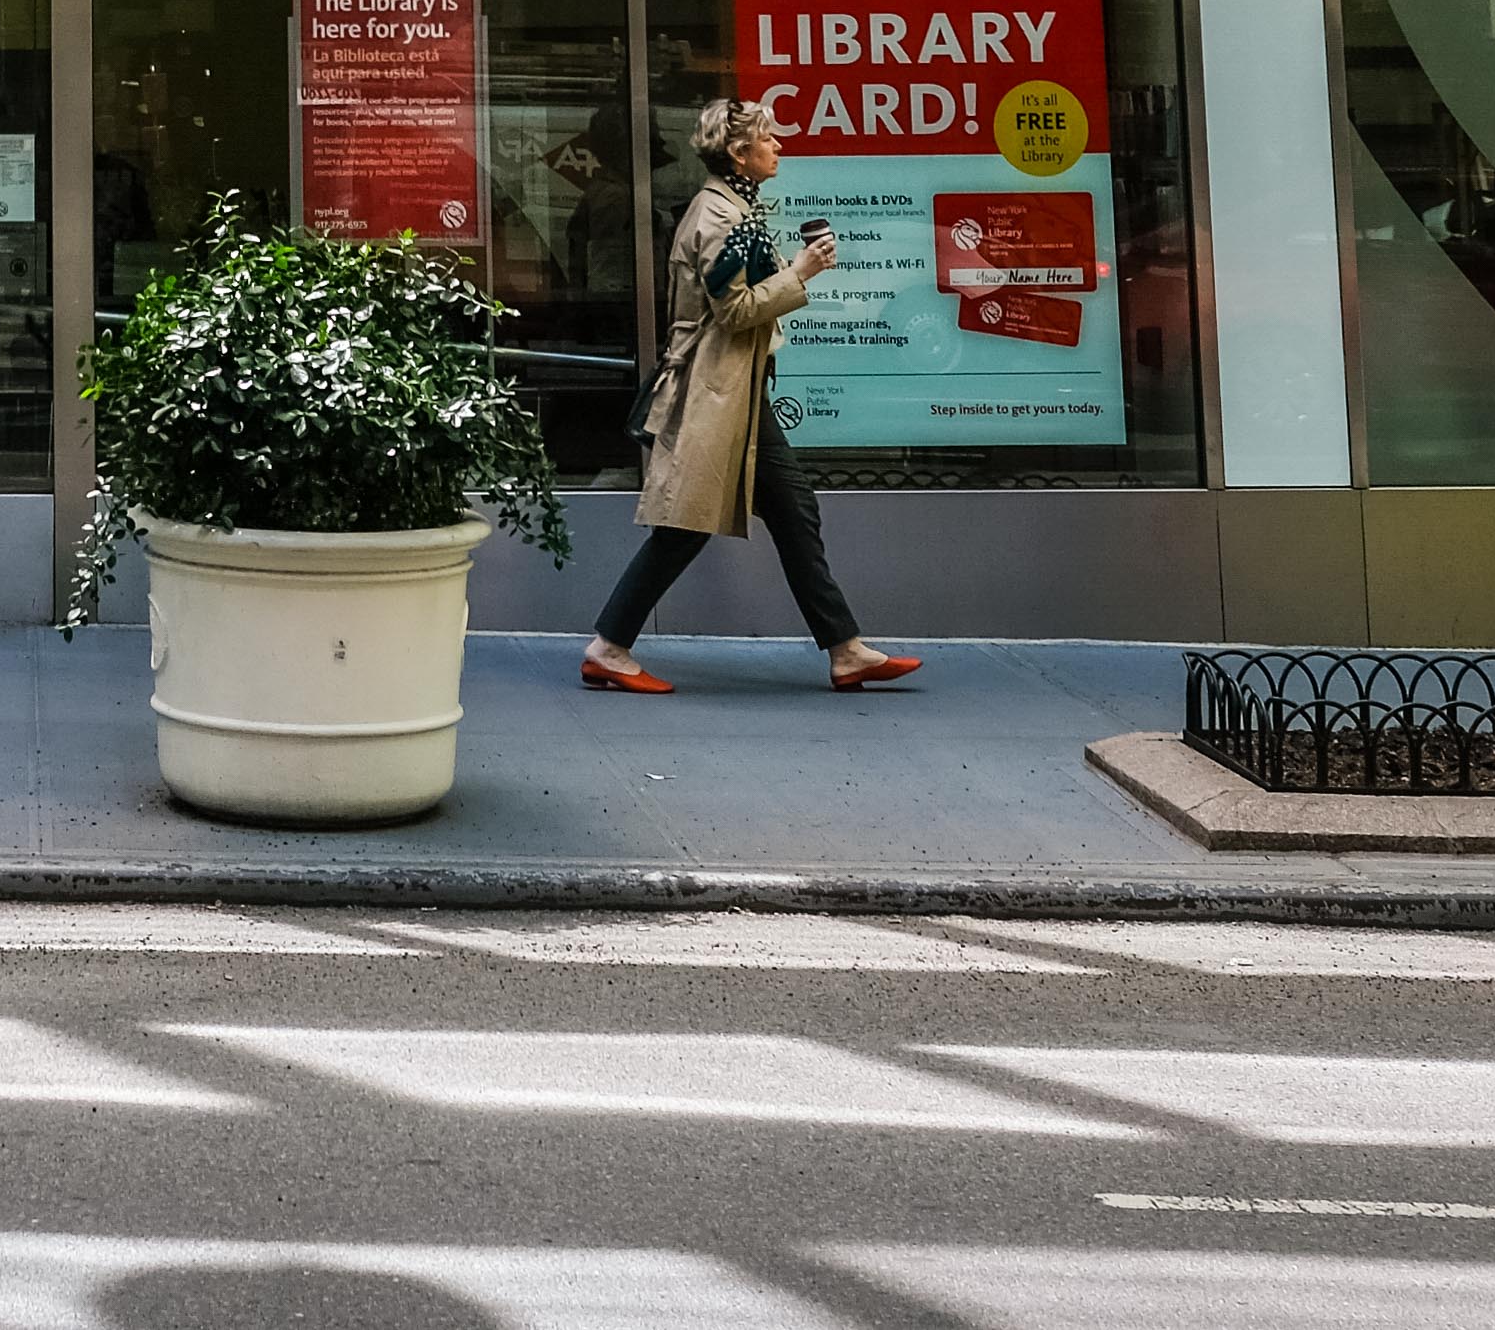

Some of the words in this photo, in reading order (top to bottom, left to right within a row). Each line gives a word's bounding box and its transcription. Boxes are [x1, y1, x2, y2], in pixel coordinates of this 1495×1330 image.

[312, 19, 362, 39] here
[366, 17, 399, 39] for
[403, 23, 451, 45] you.
[758, 11, 1057, 66] LIBRARY
[313, 48, 329, 63] La
[333, 47, 405, 63] Biblioteca
[408, 48, 440, 63] está
[312, 67, 345, 81] aquí
[347, 68, 381, 82] para
[383, 66, 429, 80] usted.
[1021, 94, 1040, 108] It's
[1042, 94, 1058, 107] all
[760, 82, 980, 137] CARD!
[1015, 112, 1067, 130] FREE
[1023, 136, 1036, 148] at
[1038, 135, 1060, 148] the
[1021, 149, 1065, 165] Library
[785, 196, 792, 206] 8
[794, 196, 833, 206] million
[835, 196, 868, 206] books
[870, 196, 879, 206] &
[881, 195, 913, 206] DVDs
[838, 230, 882, 242] e-books
[988, 227, 1023, 240] Library
[832, 260, 883, 271] mputers
[885, 259, 894, 269] &
[896, 258, 926, 269] Wi-Fi
[976, 270, 1003, 284] Your
[1008, 270, 1040, 283] Name
[1046, 269, 1073, 283] Here
[831, 290, 840, 300] &
[842, 290, 896, 301] programs
[790, 319, 828, 330] Online
[830, 319, 892, 332] magazines,
[790, 334, 846, 346] databases
[848, 334, 857, 345] &
[859, 334, 909, 347] trainings
[806, 386, 826, 396] New
[827, 385, 844, 395] York
[807, 396, 830, 406] Public
[807, 406, 840, 419] Library
[929, 404, 957, 418] Step
[959, 403, 994, 415] inside
[996, 404, 1009, 415] to
[1011, 405, 1031, 418] get
[1033, 404, 1066, 418] yours
[1068, 402, 1104, 418] today.
